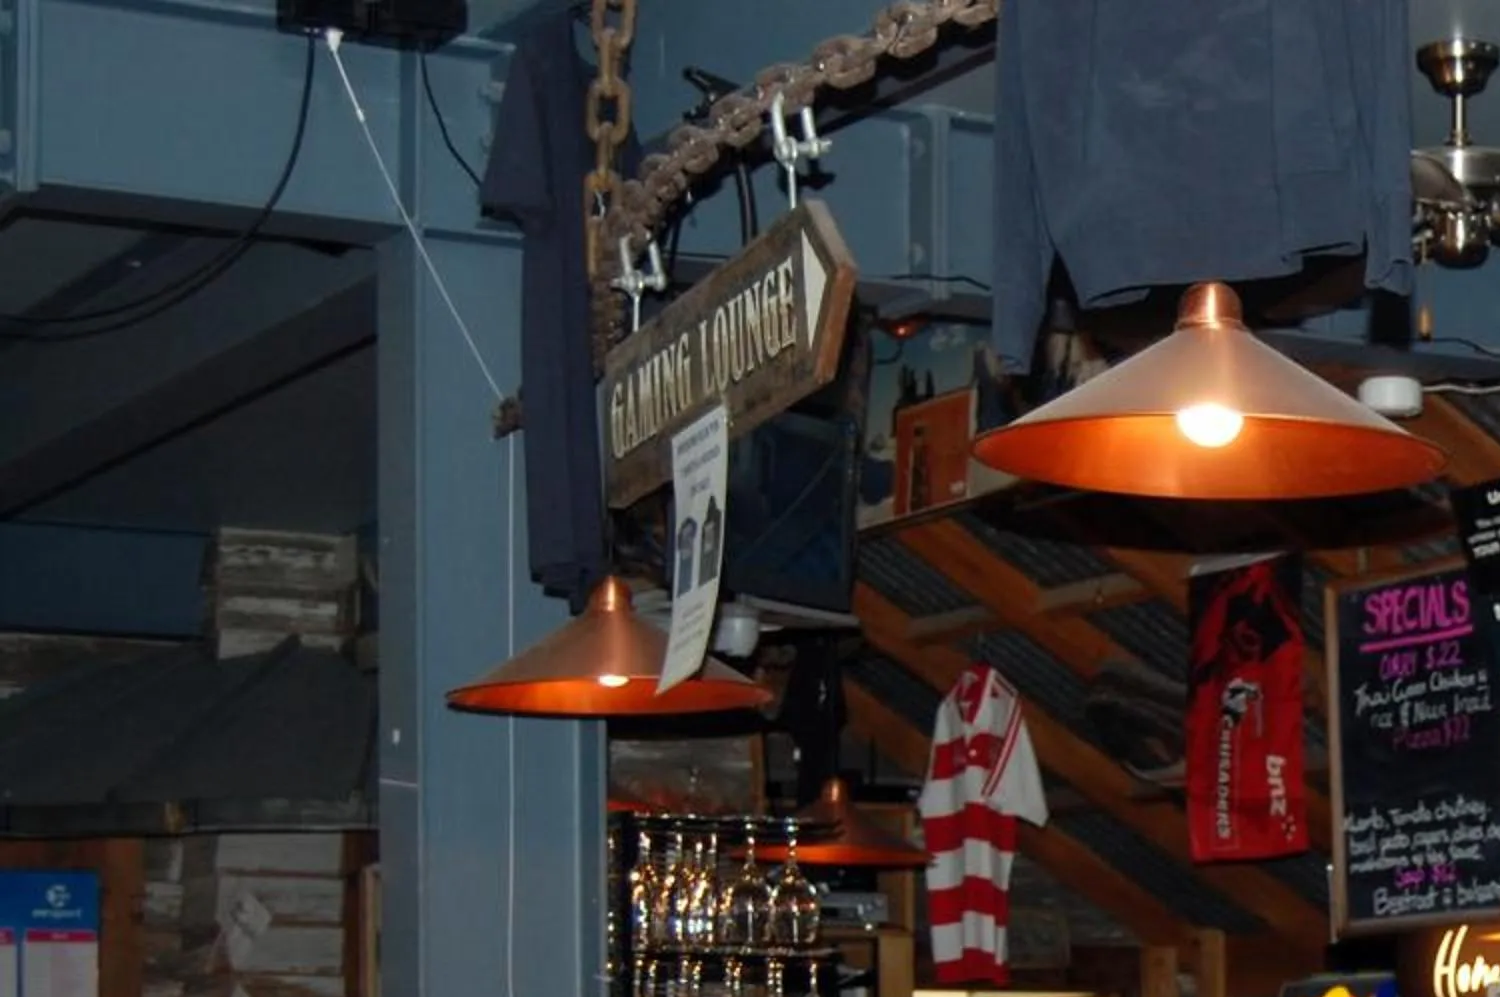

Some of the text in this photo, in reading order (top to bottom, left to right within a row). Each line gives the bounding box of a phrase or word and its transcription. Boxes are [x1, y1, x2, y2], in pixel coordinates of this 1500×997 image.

[610, 255, 798, 459] GAMING LOUNGE
[1362, 578, 1472, 634] SPECIALS
